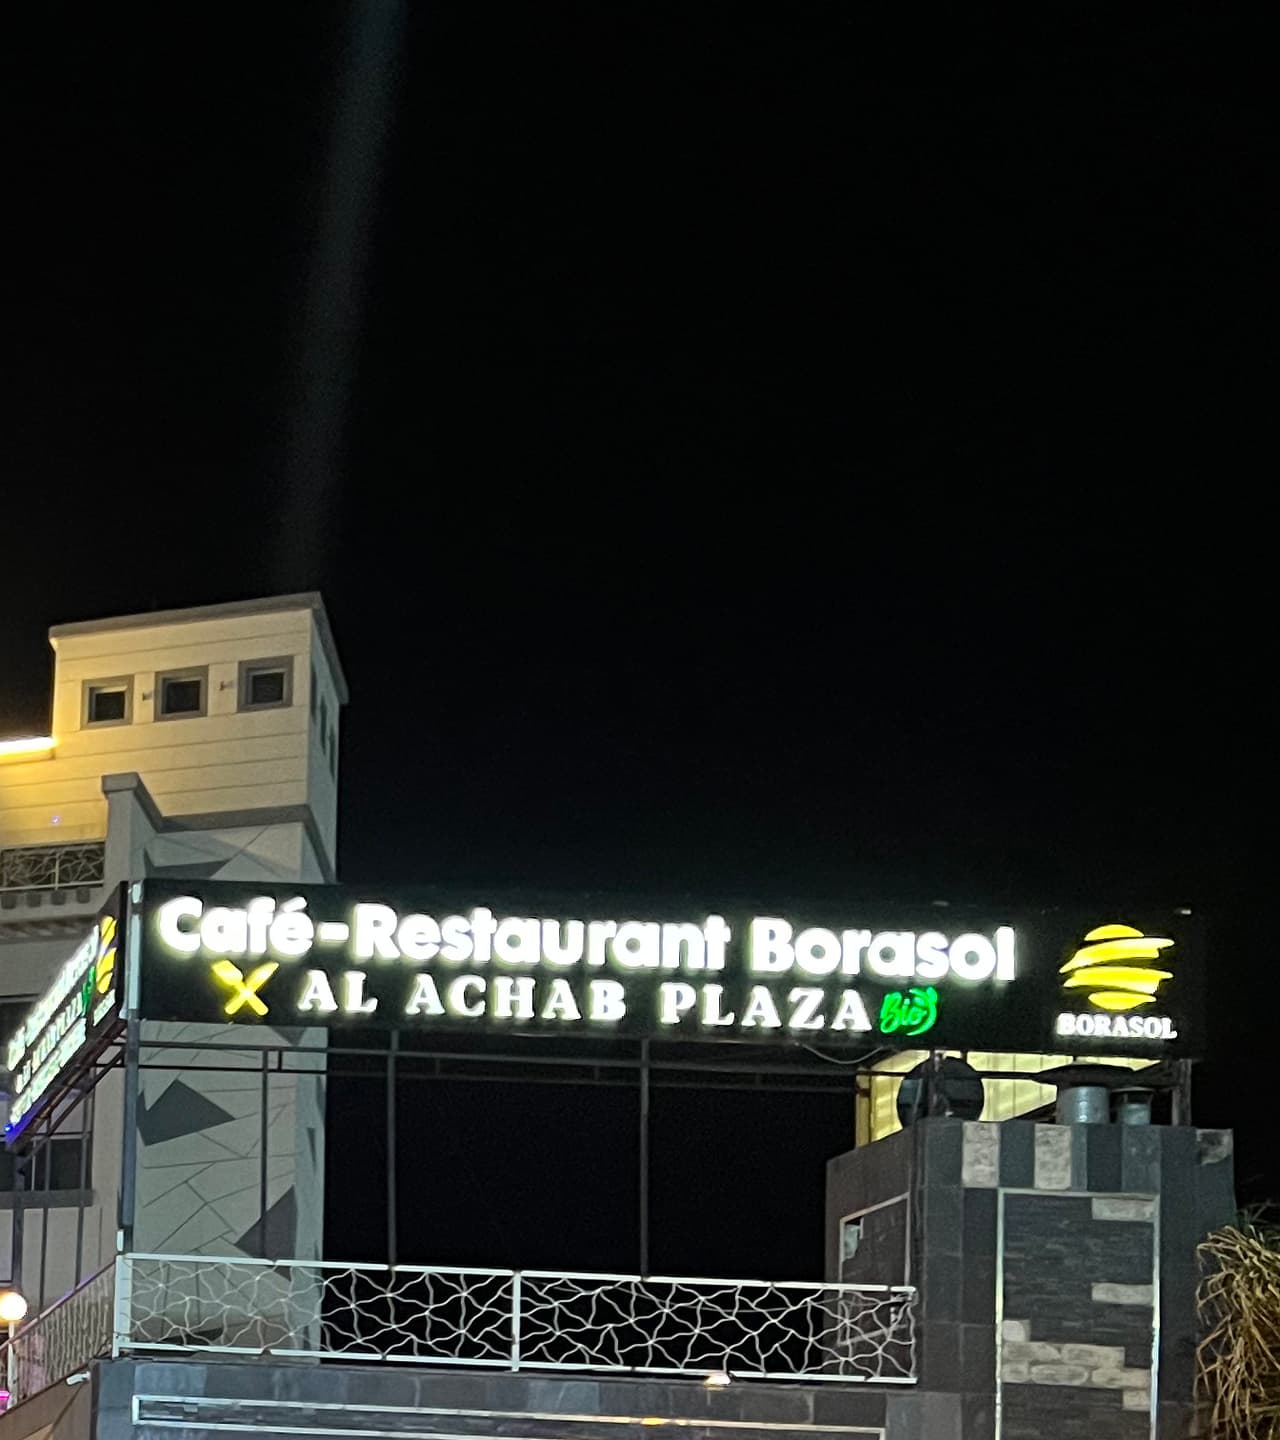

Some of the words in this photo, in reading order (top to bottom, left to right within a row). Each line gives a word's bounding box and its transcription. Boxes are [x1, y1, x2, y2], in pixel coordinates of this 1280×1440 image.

[157, 896, 732, 970] Café-Restaurant
[750, 916, 1016, 981] Borasol
[297, 969, 378, 1015] AL
[405, 973, 629, 1023] ACHAB
[659, 982, 873, 1032] PLAZA
[1056, 1011, 1179, 1040] BORASOL
